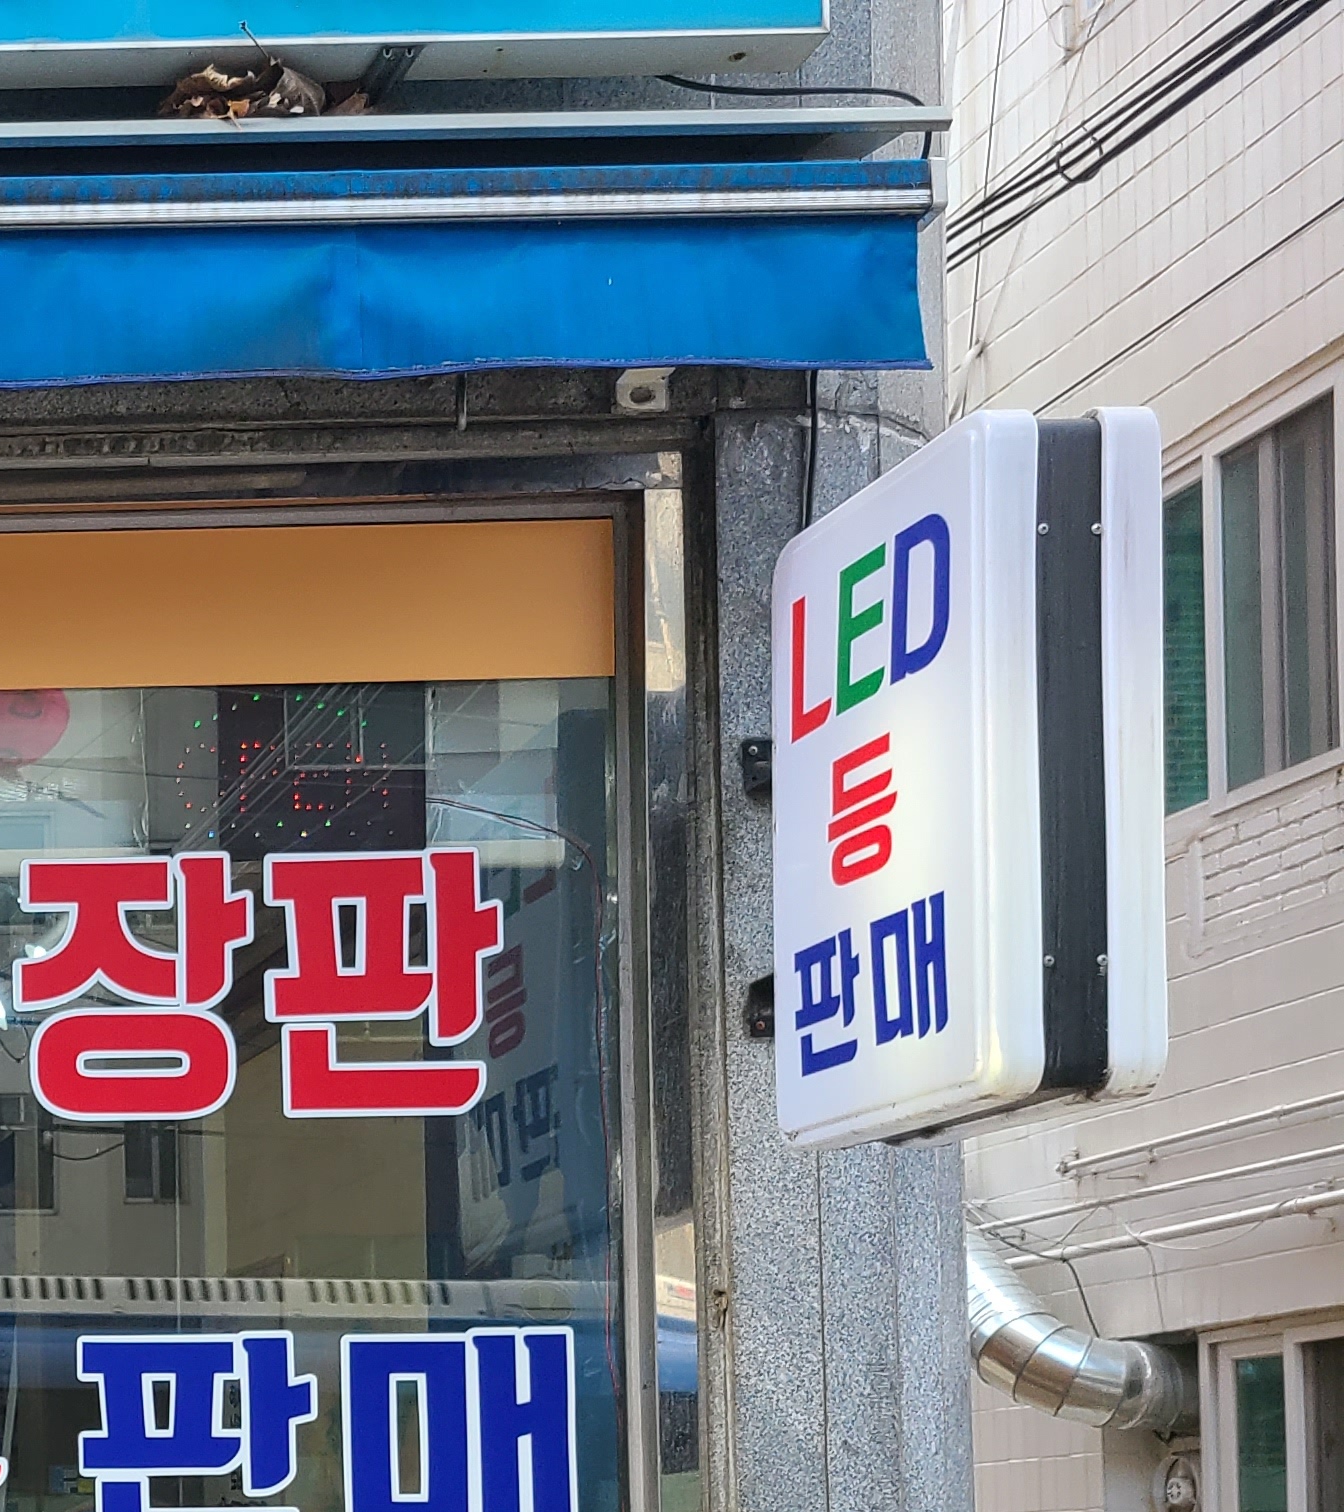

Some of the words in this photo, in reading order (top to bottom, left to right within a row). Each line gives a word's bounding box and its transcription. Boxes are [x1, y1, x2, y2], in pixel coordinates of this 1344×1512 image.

[792, 514, 950, 743] LED
[828, 732, 897, 886] 등
[794, 890, 949, 1077] 판매
